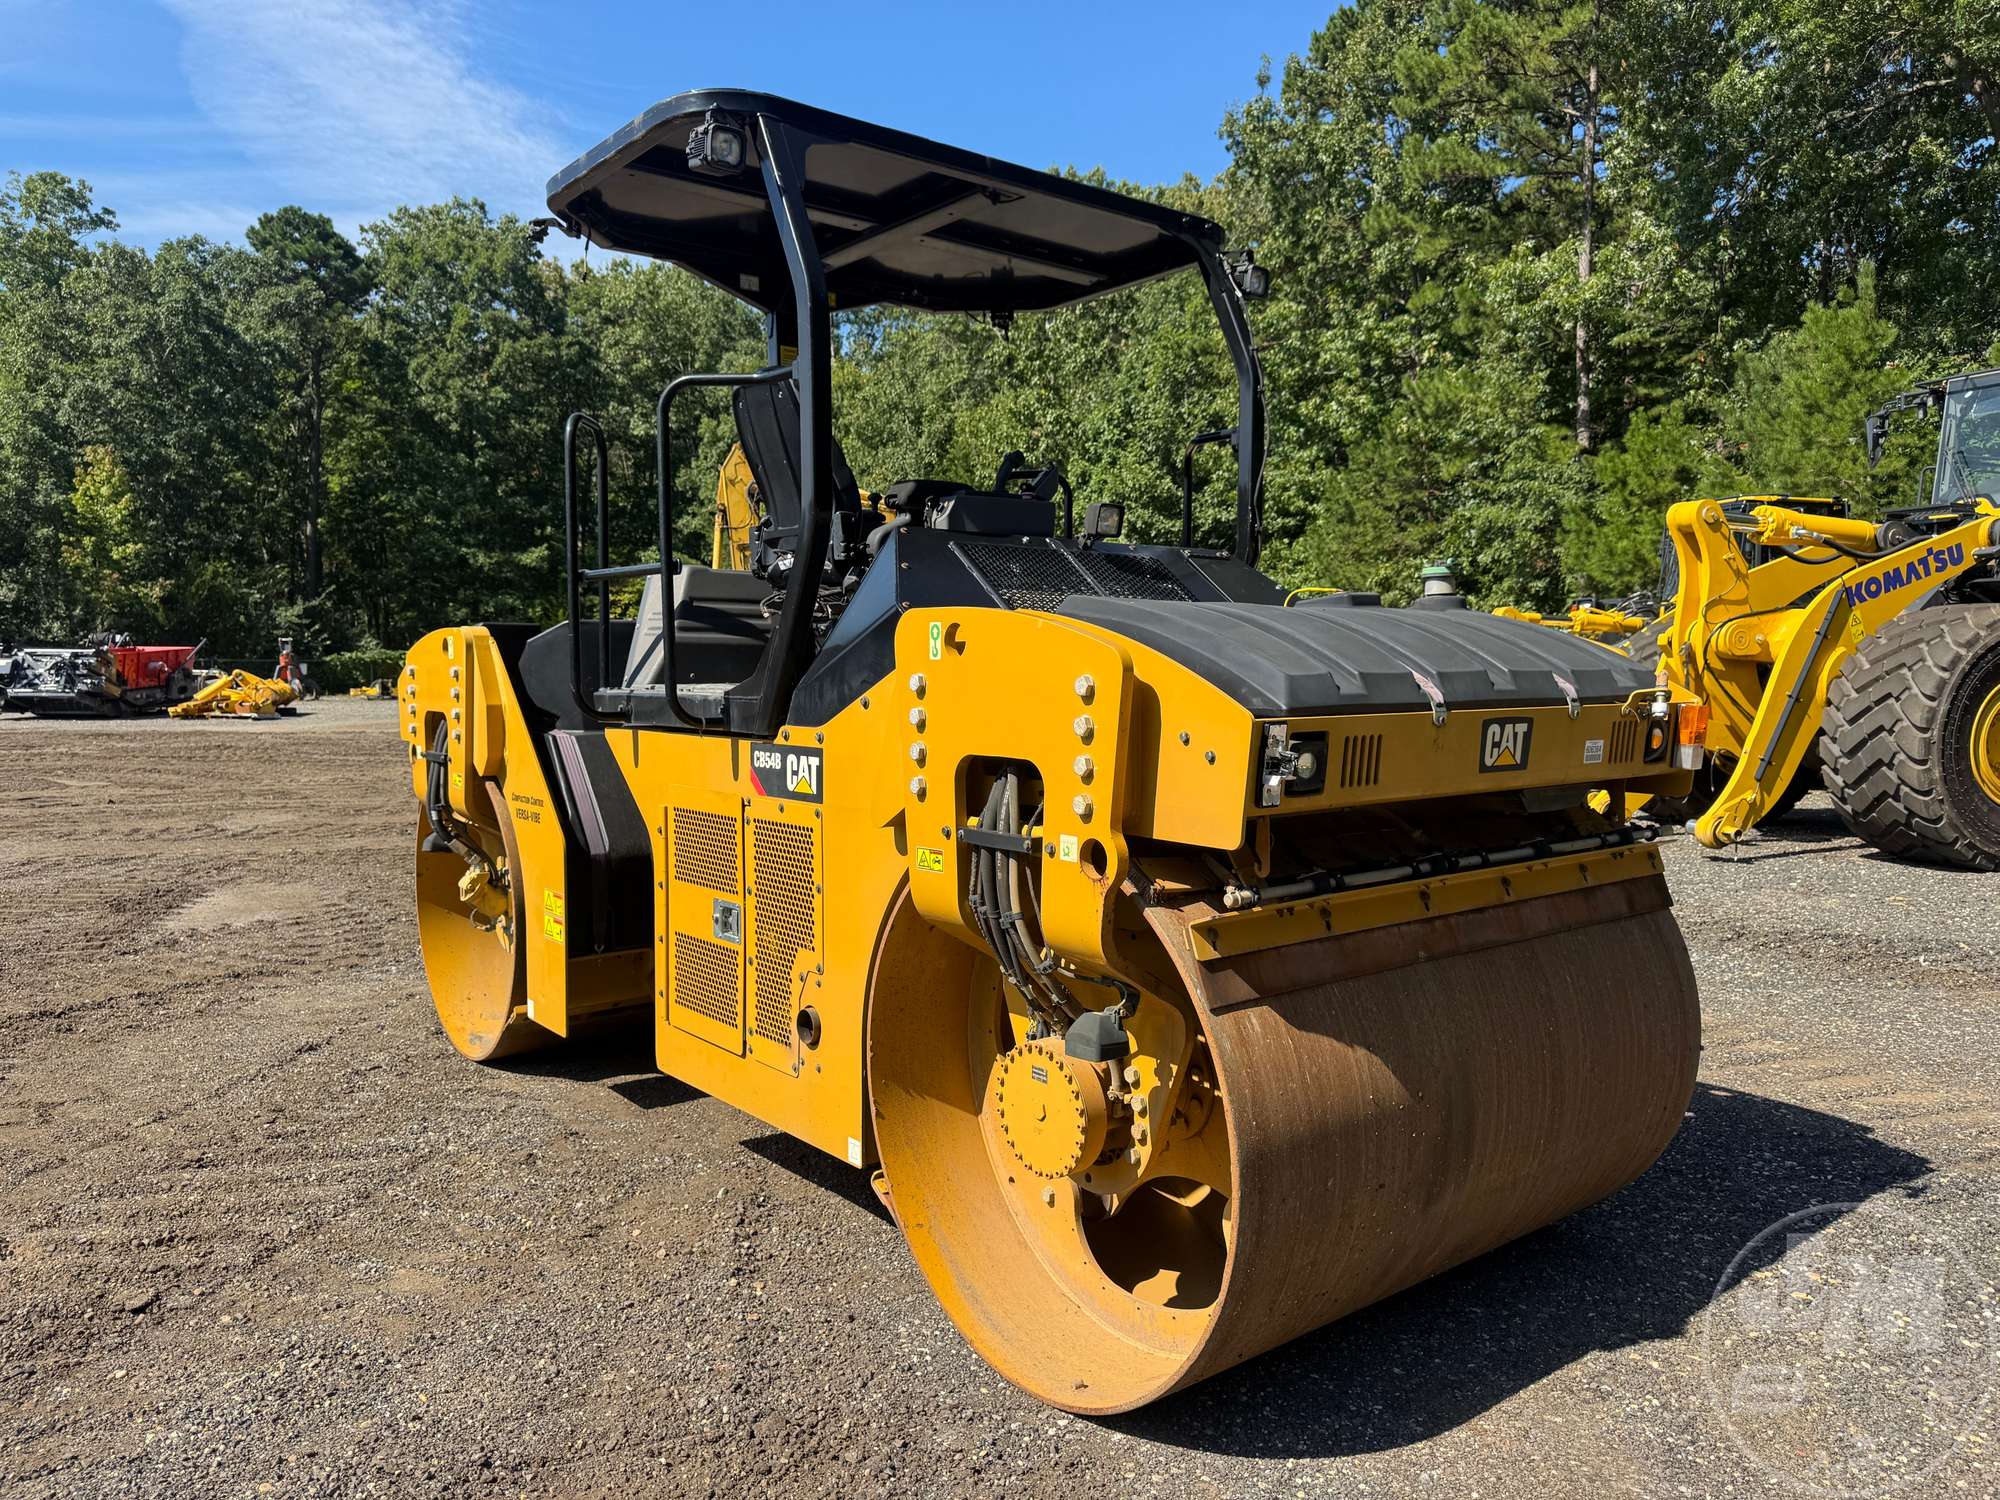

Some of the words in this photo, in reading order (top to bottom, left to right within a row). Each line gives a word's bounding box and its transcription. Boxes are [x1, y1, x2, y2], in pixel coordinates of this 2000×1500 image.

[1846, 542, 1964, 608] KOMATSU
[753, 750, 782, 770] CB54B
[1484, 723, 1528, 767] CAT
[786, 753, 820, 795] CAT
[516, 807, 541, 824] VERSA-VIBE
